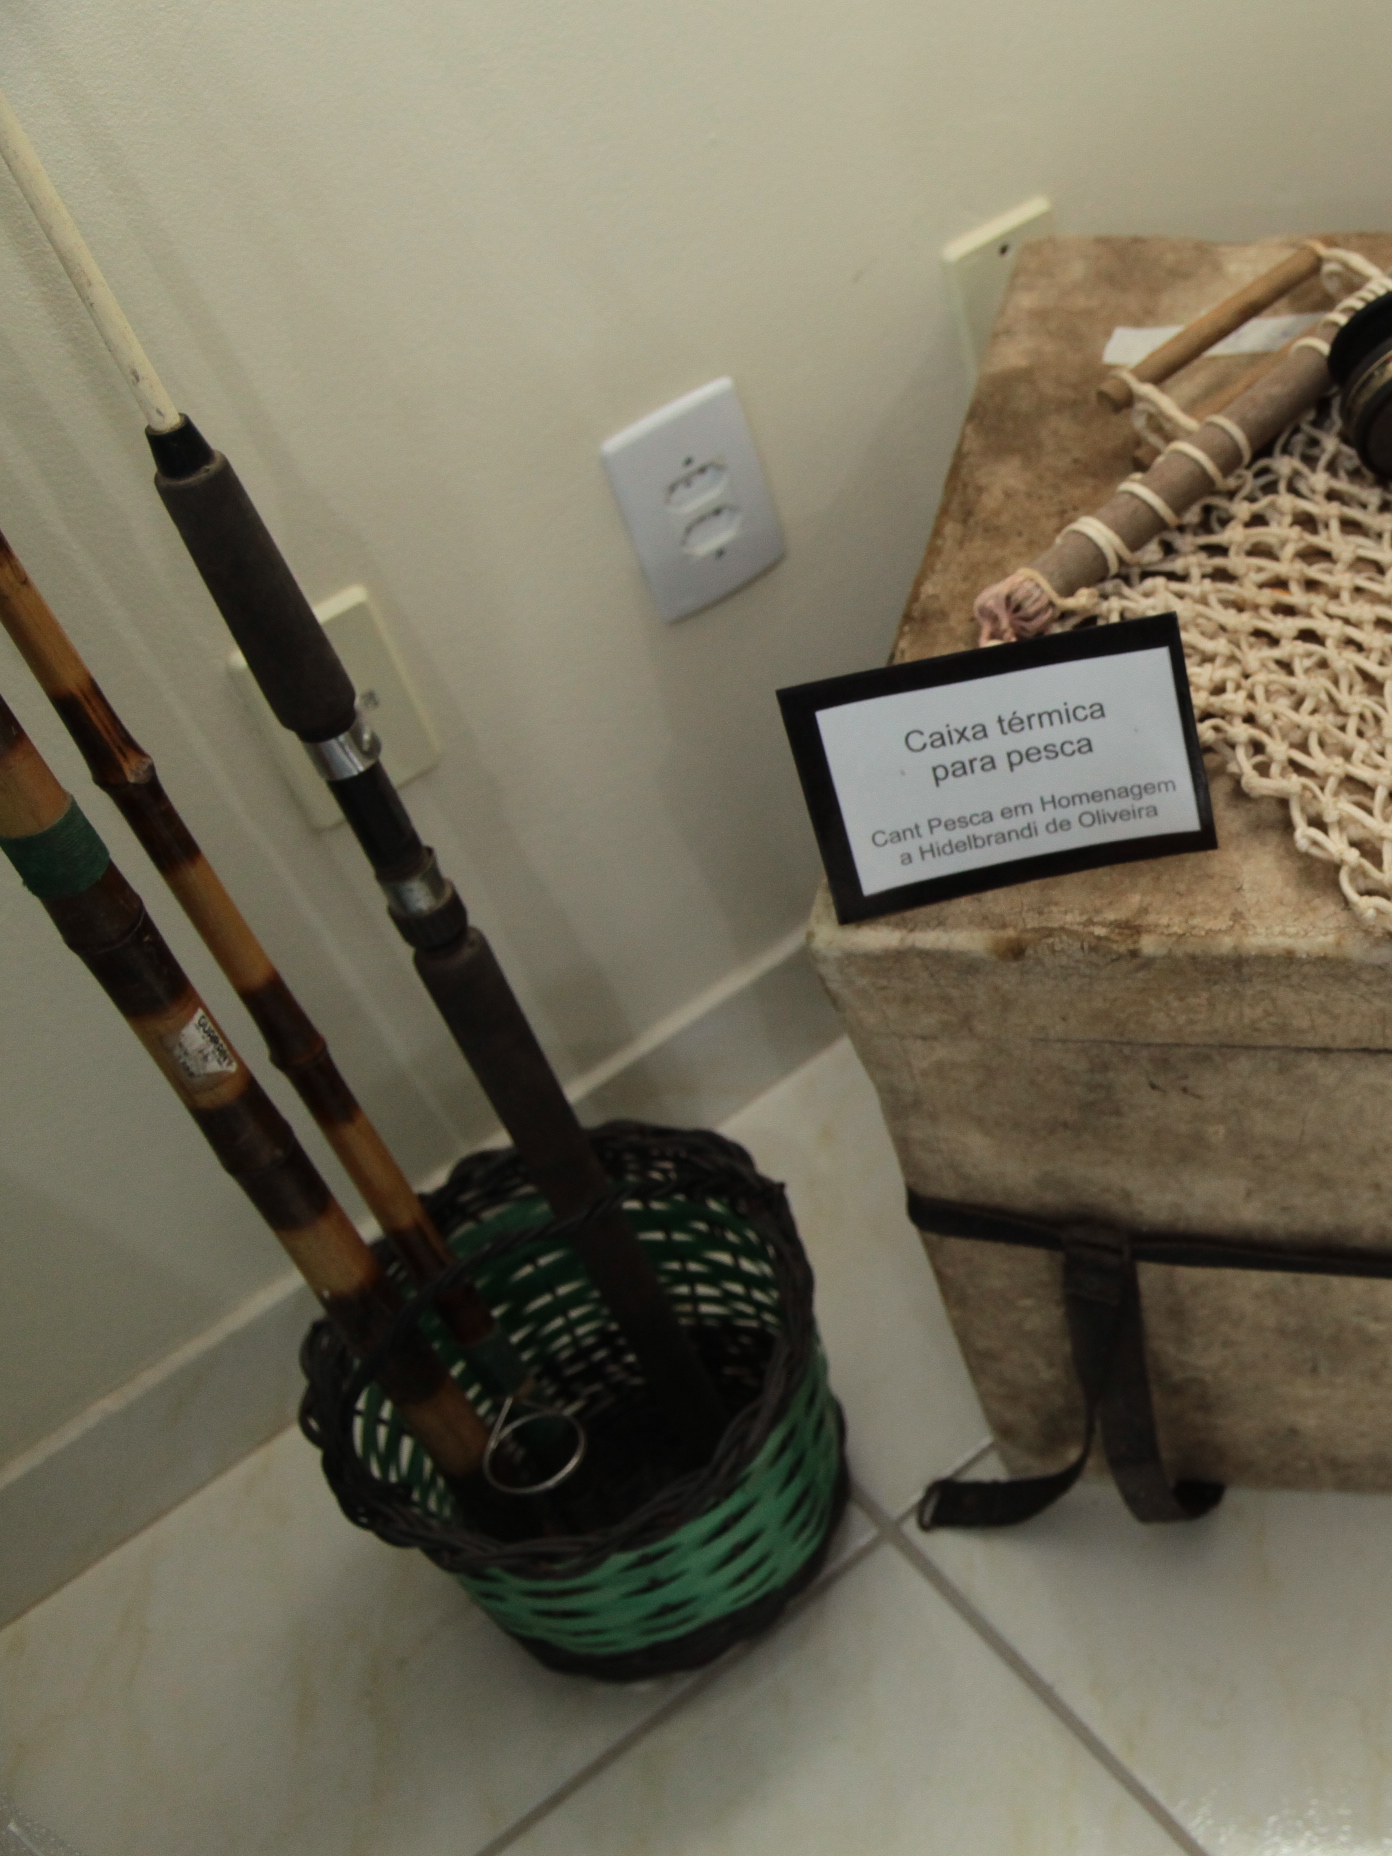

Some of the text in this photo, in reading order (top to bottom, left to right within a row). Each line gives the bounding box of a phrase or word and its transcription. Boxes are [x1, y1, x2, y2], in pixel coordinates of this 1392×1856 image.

[904, 702, 1106, 753] Caixa térmica
[932, 737, 1093, 787] para pesca
[871, 780, 1176, 848] Cant Pesca em Homenagem
[900, 797, 1158, 865] a Hidelbrandi de Oliveira
